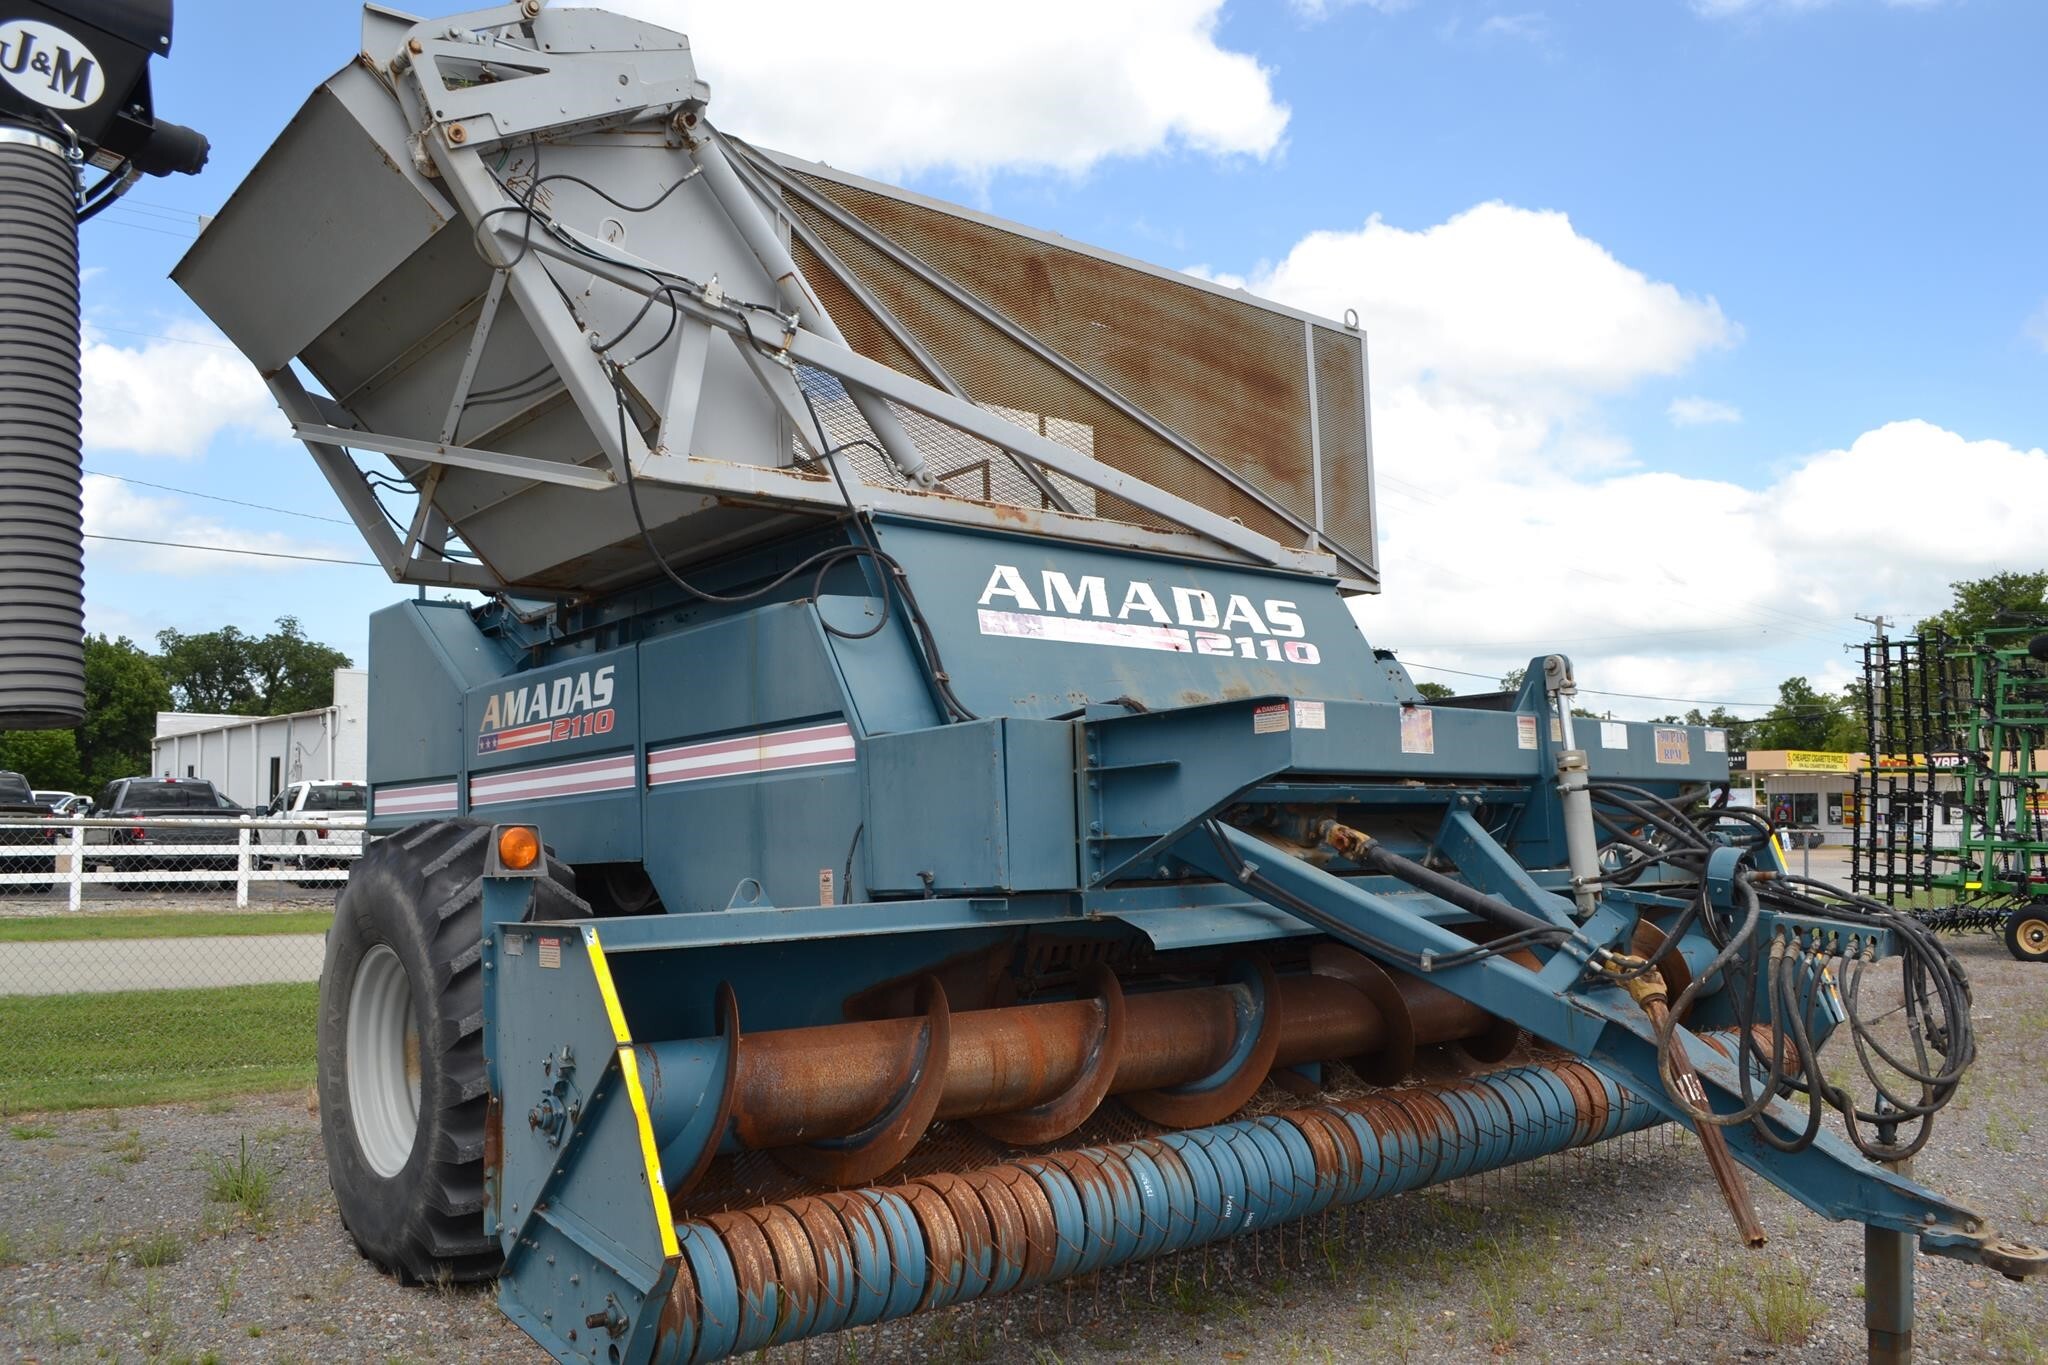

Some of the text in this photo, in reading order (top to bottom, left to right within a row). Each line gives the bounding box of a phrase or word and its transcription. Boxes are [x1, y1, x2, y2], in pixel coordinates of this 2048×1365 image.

[0, 31, 95, 104] J&M
[977, 564, 1306, 639] AMADAS
[1194, 630, 1321, 665] 2110
[480, 665, 615, 732] AMADAS
[1261, 704, 1286, 713] DANGER
[551, 708, 615, 742] 2110
[1664, 749, 1682, 760] RPM
[1792, 753, 1811, 762] CHEAPEST
[1812, 754, 1831, 763] CIGARETTE
